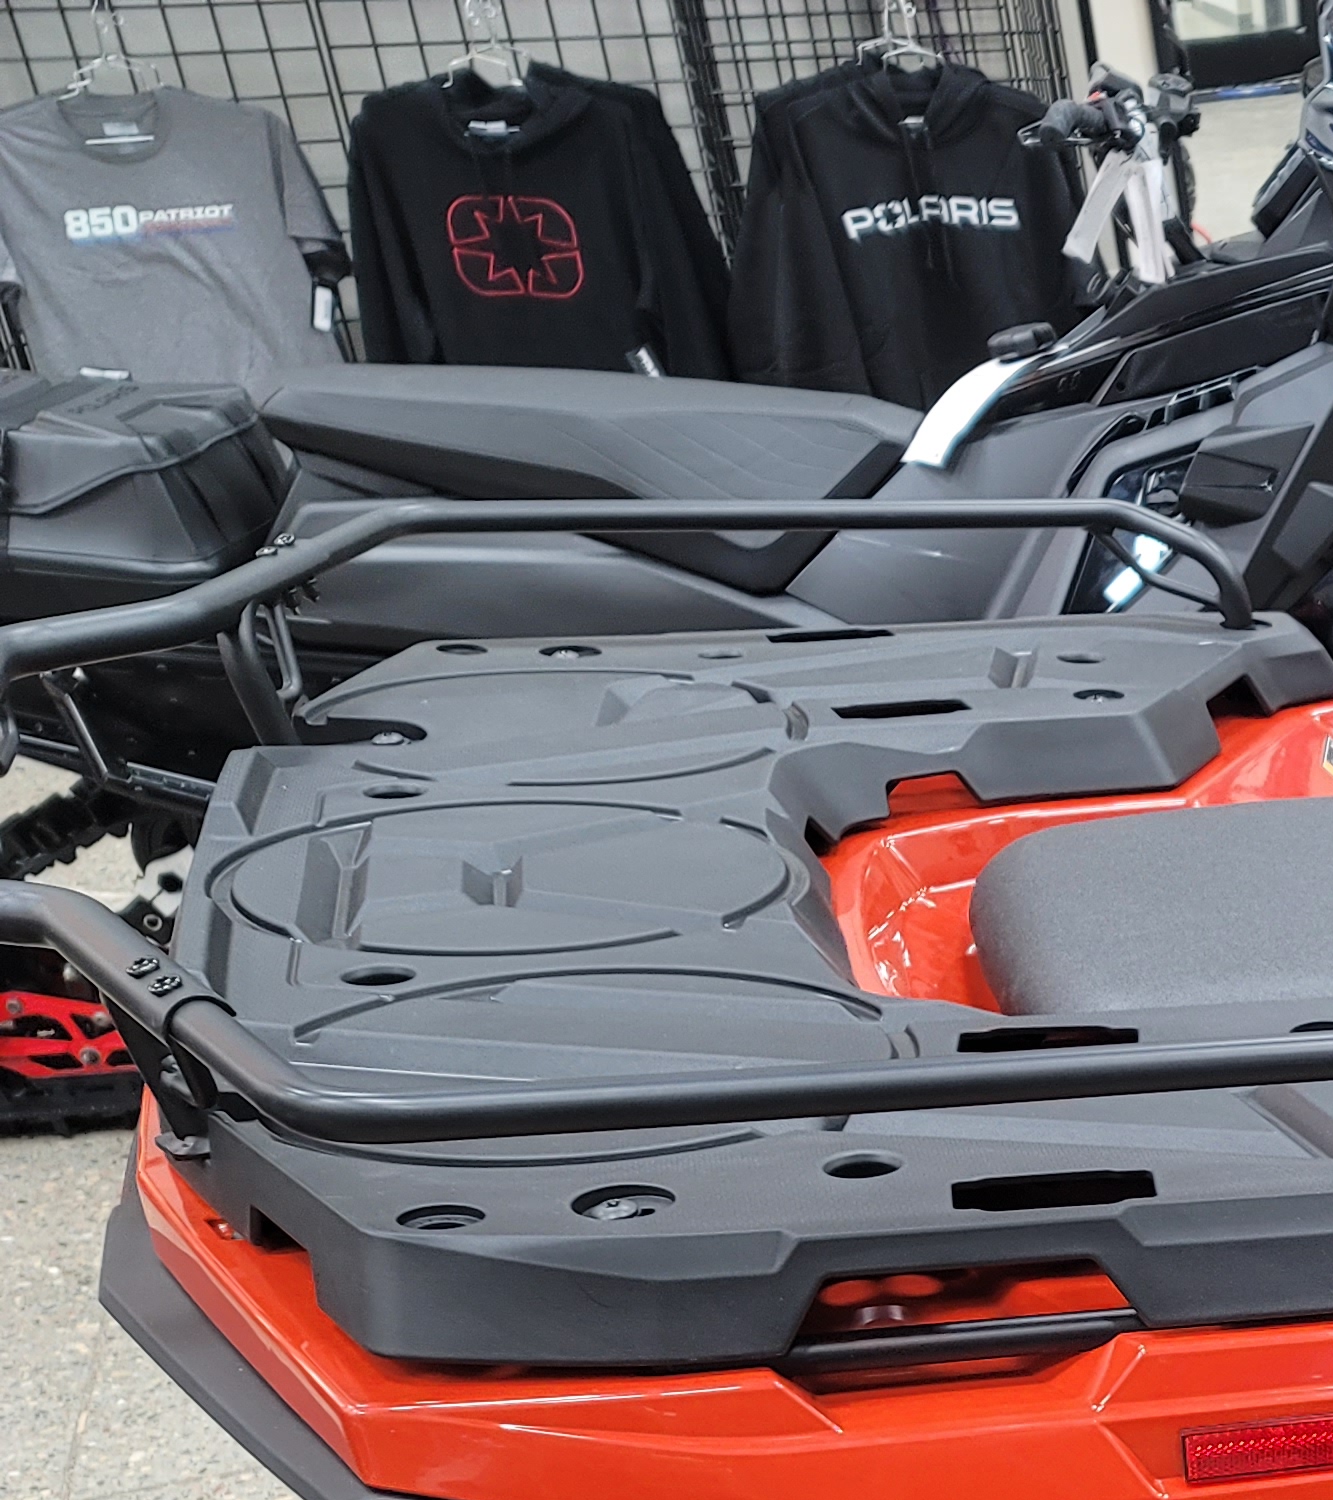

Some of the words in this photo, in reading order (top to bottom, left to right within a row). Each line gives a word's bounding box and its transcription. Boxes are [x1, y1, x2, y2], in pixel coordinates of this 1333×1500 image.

[63, 204, 138, 240] 850
[138, 203, 234, 223] PATRIOT
[841, 193, 1020, 240] POLARIS
